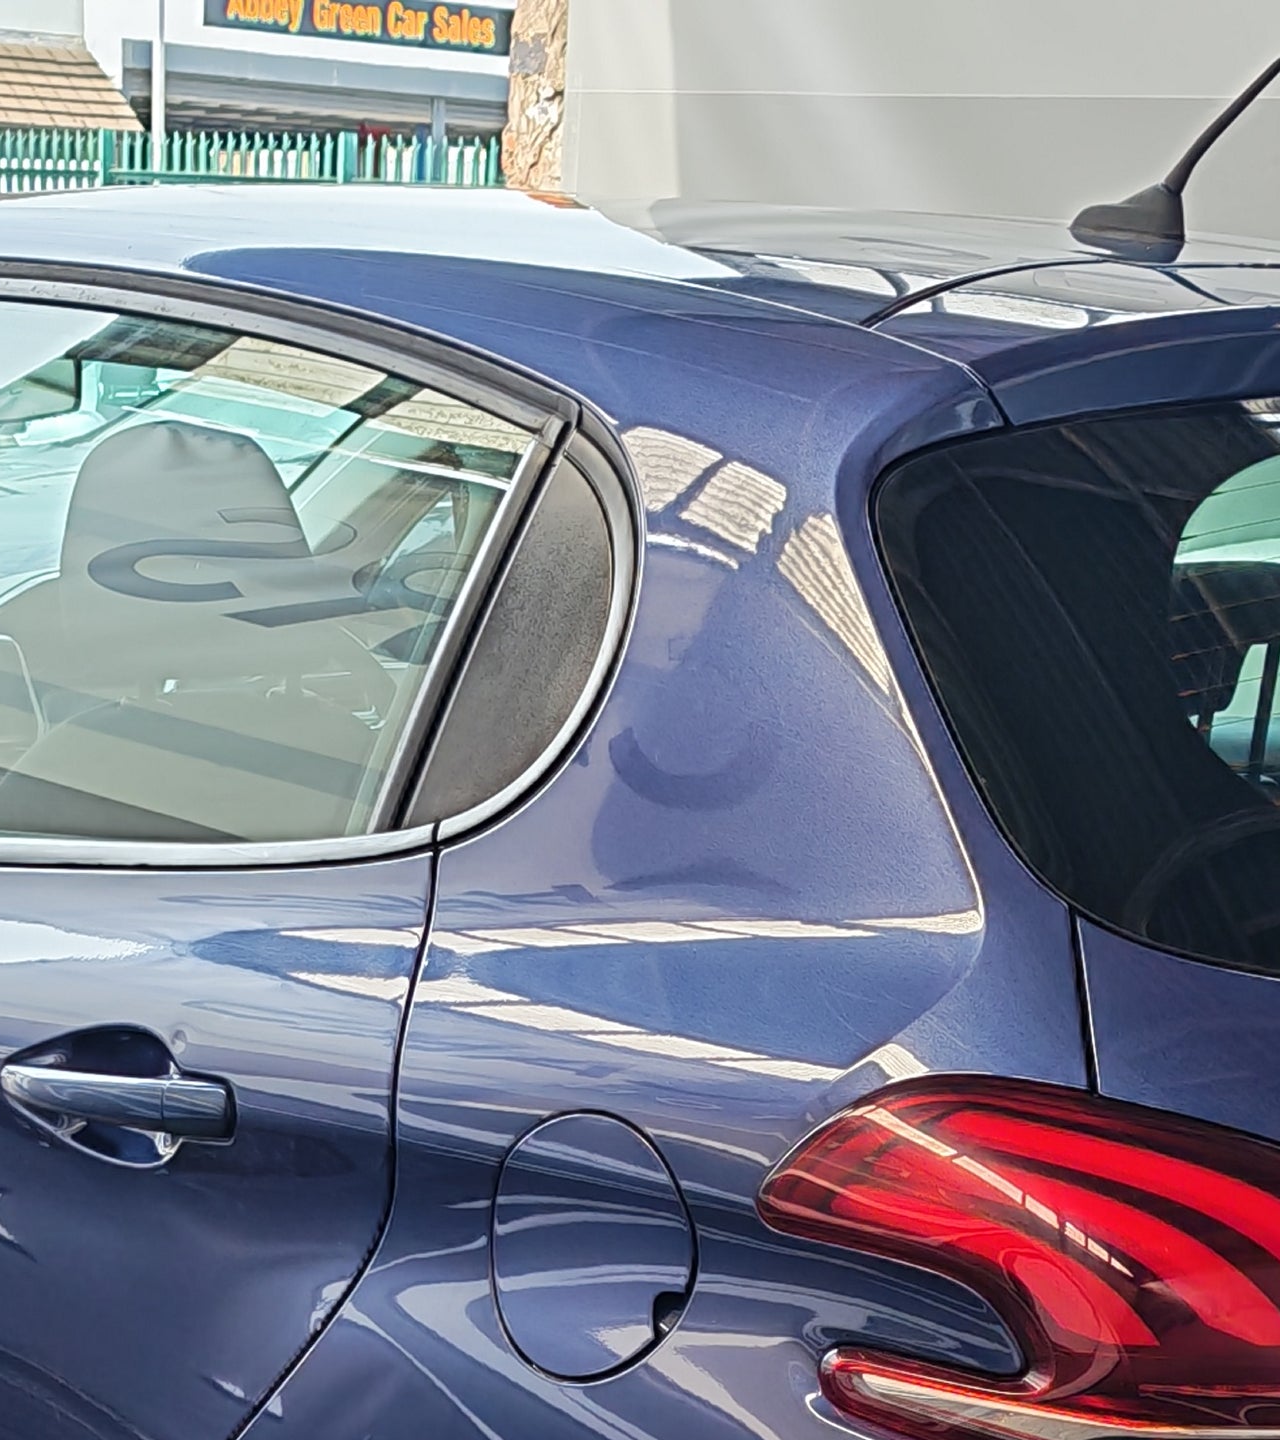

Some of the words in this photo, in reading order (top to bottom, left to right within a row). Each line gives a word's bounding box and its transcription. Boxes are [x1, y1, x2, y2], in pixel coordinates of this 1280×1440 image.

[225, 0, 304, 32] Abbey
[312, 0, 381, 37] Green
[386, 1, 428, 39] Car
[432, 6, 496, 48] Sales
